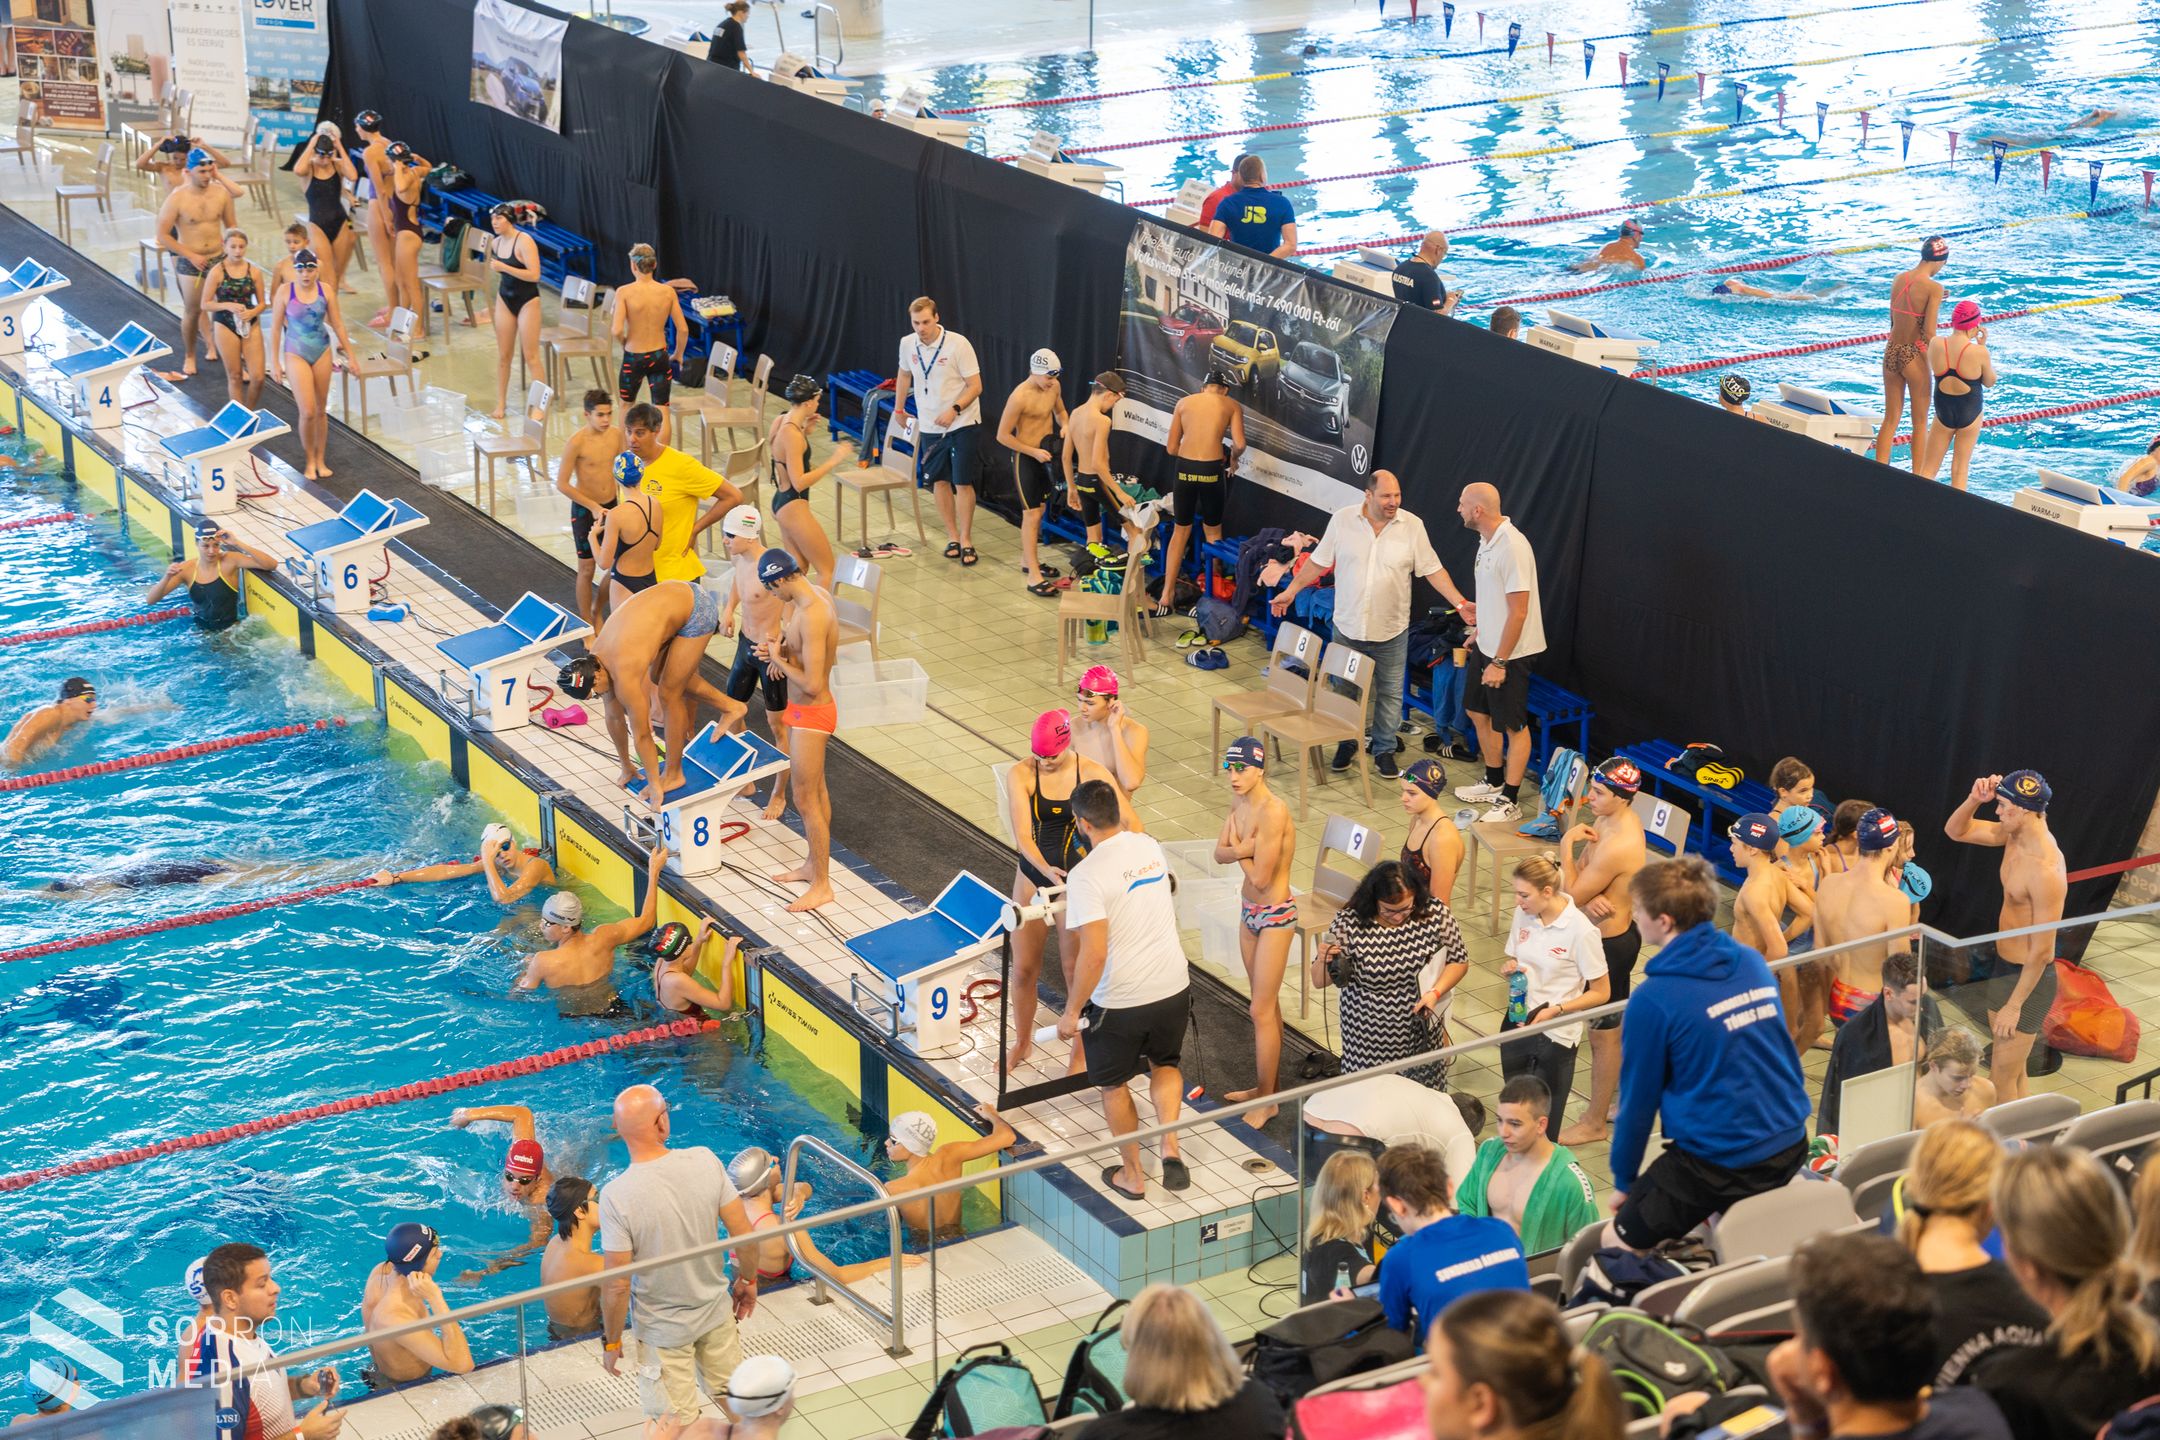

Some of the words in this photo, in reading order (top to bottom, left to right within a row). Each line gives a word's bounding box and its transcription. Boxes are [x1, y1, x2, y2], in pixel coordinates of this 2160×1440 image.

[1133, 249, 1181, 278] Volkswagen
[1182, 267, 1205, 285] Start
[1207, 277, 1246, 300] modellek
[1246, 292, 1265, 306] már
[1265, 295, 1274, 308] 7
[1274, 299, 1292, 315] 490
[1293, 305, 1312, 321] 000
[1312, 311, 1341, 332] Ft-tól
[3, 316, 15, 336] 3
[1539, 338, 1561, 350] WARM-UP
[99, 386, 112, 408] 4
[1727, 377, 1745, 397] XBS
[1123, 410, 1145, 422] Walter
[212, 468, 225, 491] 5
[2030, 504, 2061, 519] WARM-UP
[321, 561, 328, 586] 6
[344, 564, 358, 590] 6
[1298, 636, 1307, 652] 8
[1348, 658, 1357, 674] 8
[475, 673, 482, 700] 7
[501, 677, 516, 706] 7
[1569, 766, 1578, 784] 9
[662, 811, 671, 841] 8
[1655, 809, 1667, 828] 9
[693, 816, 709, 847] 8
[1353, 832, 1363, 850] 9
[565, 835, 583, 851] SWISS
[661, 930, 678, 950] HUN
[895, 984, 906, 1013] 9
[931, 987, 948, 1020] 9
[776, 1000, 798, 1019] SWISS
[910, 1118, 936, 1142] XBS
[513, 1153, 534, 1164] arena
[1934, 1331, 1992, 1393] VIENNA
[1993, 1324, 2044, 1346] AQUA
[216, 1414, 239, 1424] LYSI
